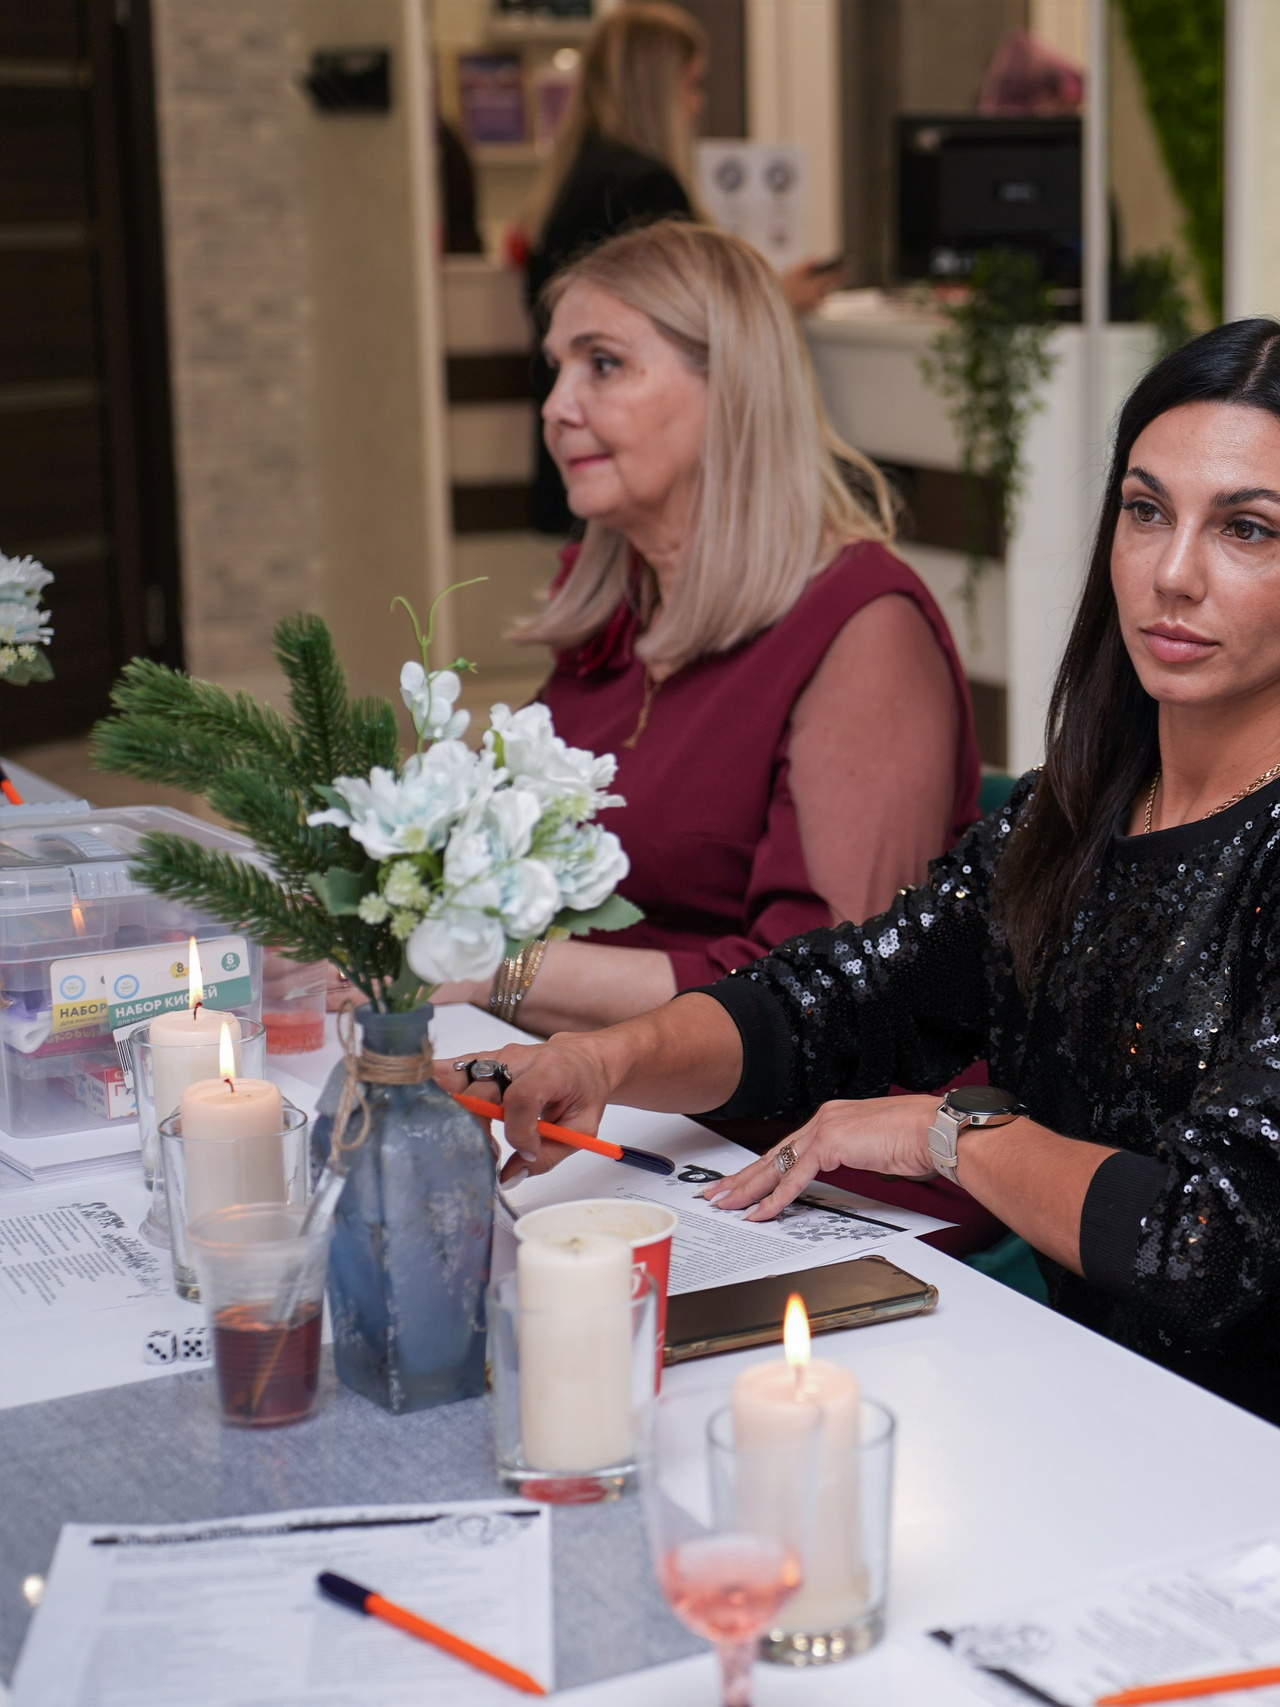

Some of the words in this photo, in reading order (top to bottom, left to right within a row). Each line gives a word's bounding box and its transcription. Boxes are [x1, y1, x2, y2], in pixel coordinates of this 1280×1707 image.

[226, 954, 235, 965] 8
[177, 962, 184, 973] 8
[115, 998, 162, 1018] НАБОР
[164, 985, 218, 1008] КИСЕЙ
[60, 1003, 107, 1018] НАБОР
